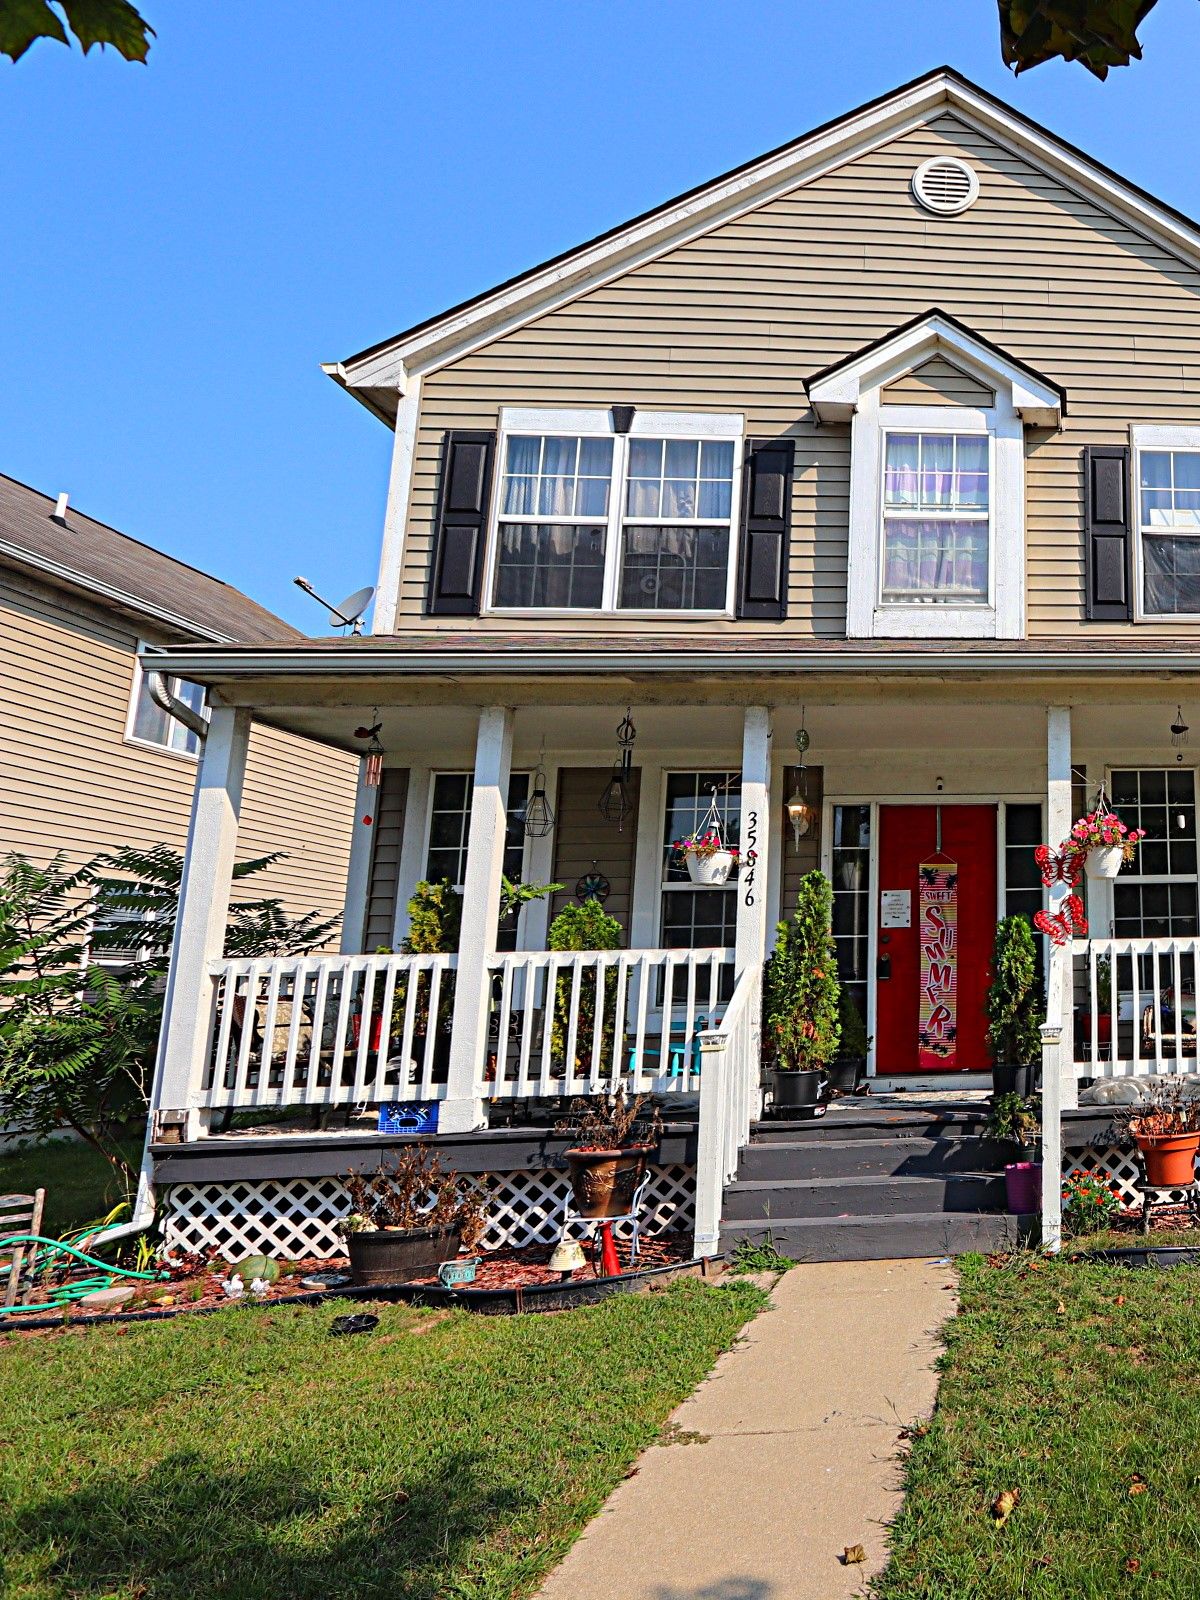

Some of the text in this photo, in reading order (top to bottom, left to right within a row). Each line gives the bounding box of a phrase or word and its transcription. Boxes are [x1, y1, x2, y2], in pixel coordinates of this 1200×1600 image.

[745, 811, 758, 907] 35846
[925, 891, 952, 901] SWEET
[925, 905, 953, 1039] SUMMER
